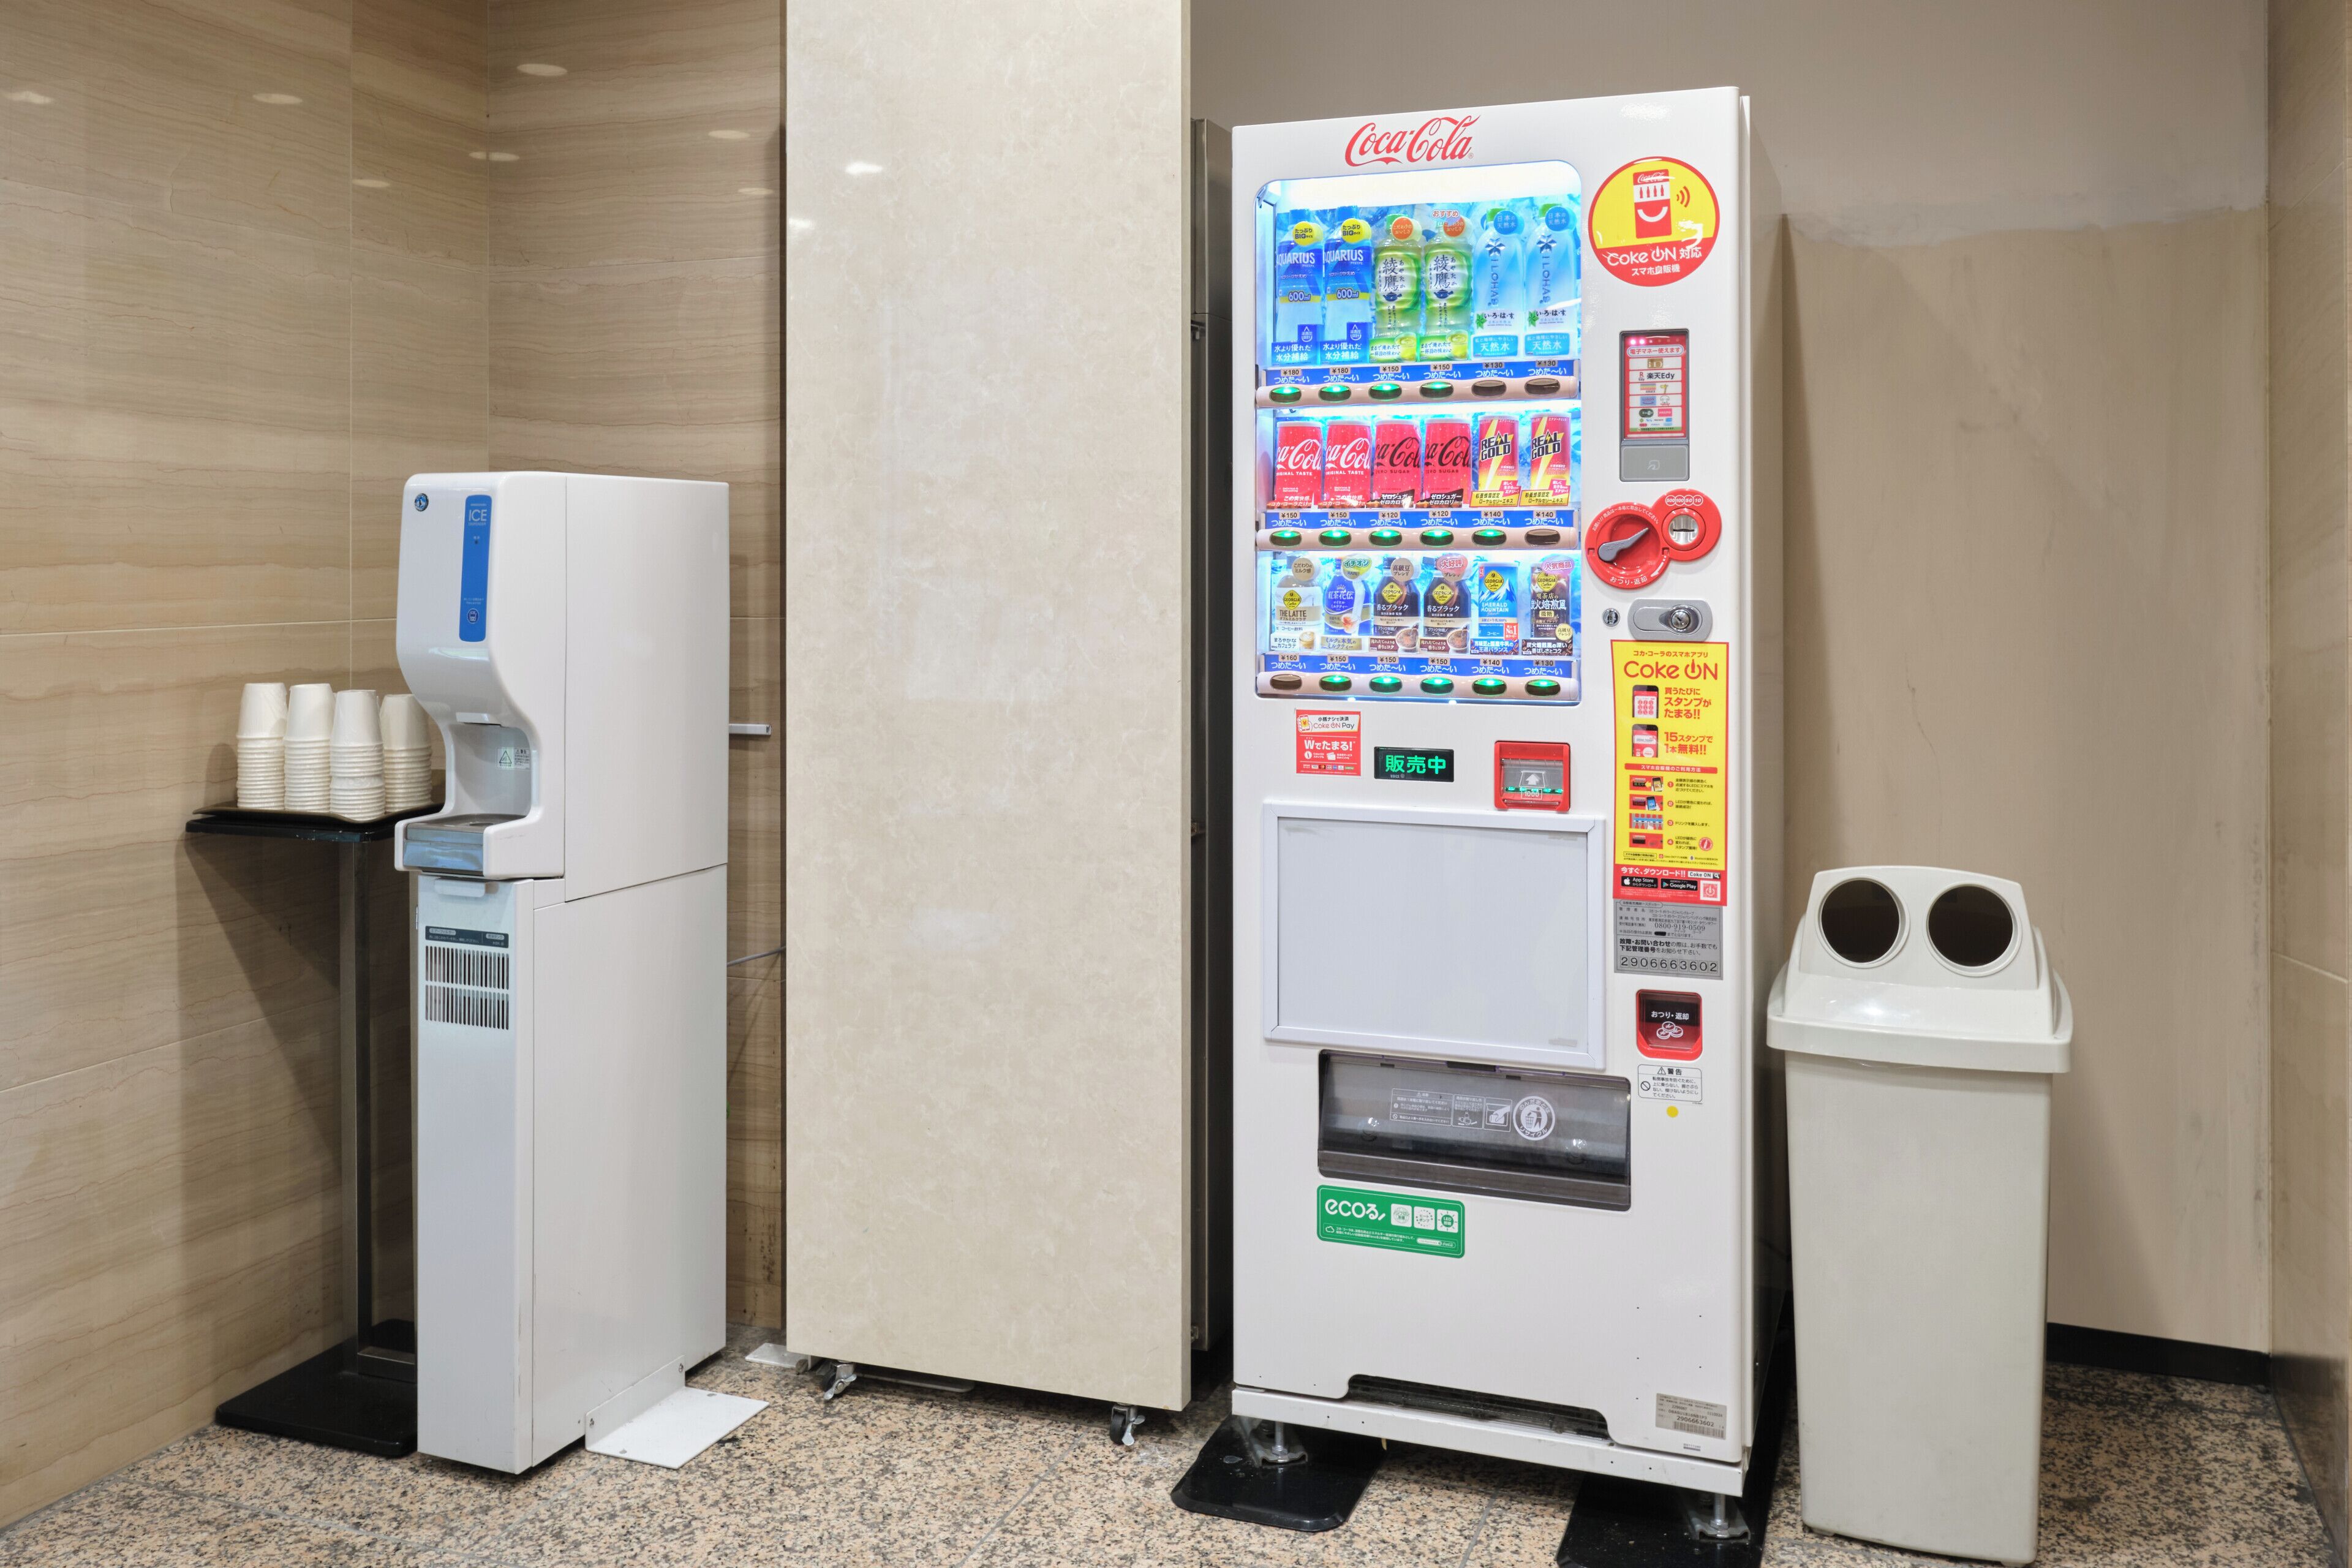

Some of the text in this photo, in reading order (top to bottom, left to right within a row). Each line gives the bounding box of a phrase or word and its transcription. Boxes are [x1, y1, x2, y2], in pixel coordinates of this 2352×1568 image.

[1345, 115, 1480, 167] Coca-Cola
[1607, 246, 1703, 266] Coke ON 対応
[1383, 257, 1398, 291] 綾鷹
[1434, 254, 1449, 289] 綾鷹
[1632, 264, 1681, 277] スマホ自販機
[1289, 291, 1311, 302] 600ml
[1337, 288, 1359, 299] 600ml
[1480, 342, 1510, 352] 天然水
[1532, 341, 1562, 350] 天然水
[1276, 352, 1309, 362] 水分補給
[1325, 351, 1359, 360] 水分補給
[1482, 431, 1510, 449] REAL
[1532, 429, 1562, 448] REAL
[1481, 443, 1511, 461] GOLD
[1532, 442, 1561, 460] GOLD
[469, 509, 488, 522] ICE
[1343, 559, 1370, 568] イチオシ
[1441, 559, 1463, 568] 大好評
[1545, 561, 1572, 570] 人気商品
[1328, 591, 1354, 600] 紅茶花伝
[1624, 659, 1718, 680] Coke ON
[1664, 697, 1711, 707] スタンプが
[1664, 709, 1700, 719] たまる!!
[1664, 731, 1713, 743] 15スタンプで
[1304, 739, 1352, 751] Wでたまる!
[1664, 744, 1706, 755] 1本無料!!
[1385, 755, 1446, 775] 販売中
[1621, 867, 1686, 877] 今すぐ、ダウンロード!!
[1654, 922, 1706, 932] 0800-919-0509
[1621, 957, 1718, 973] 2906663602
[1520, 1126, 1548, 1137] リサイクル
